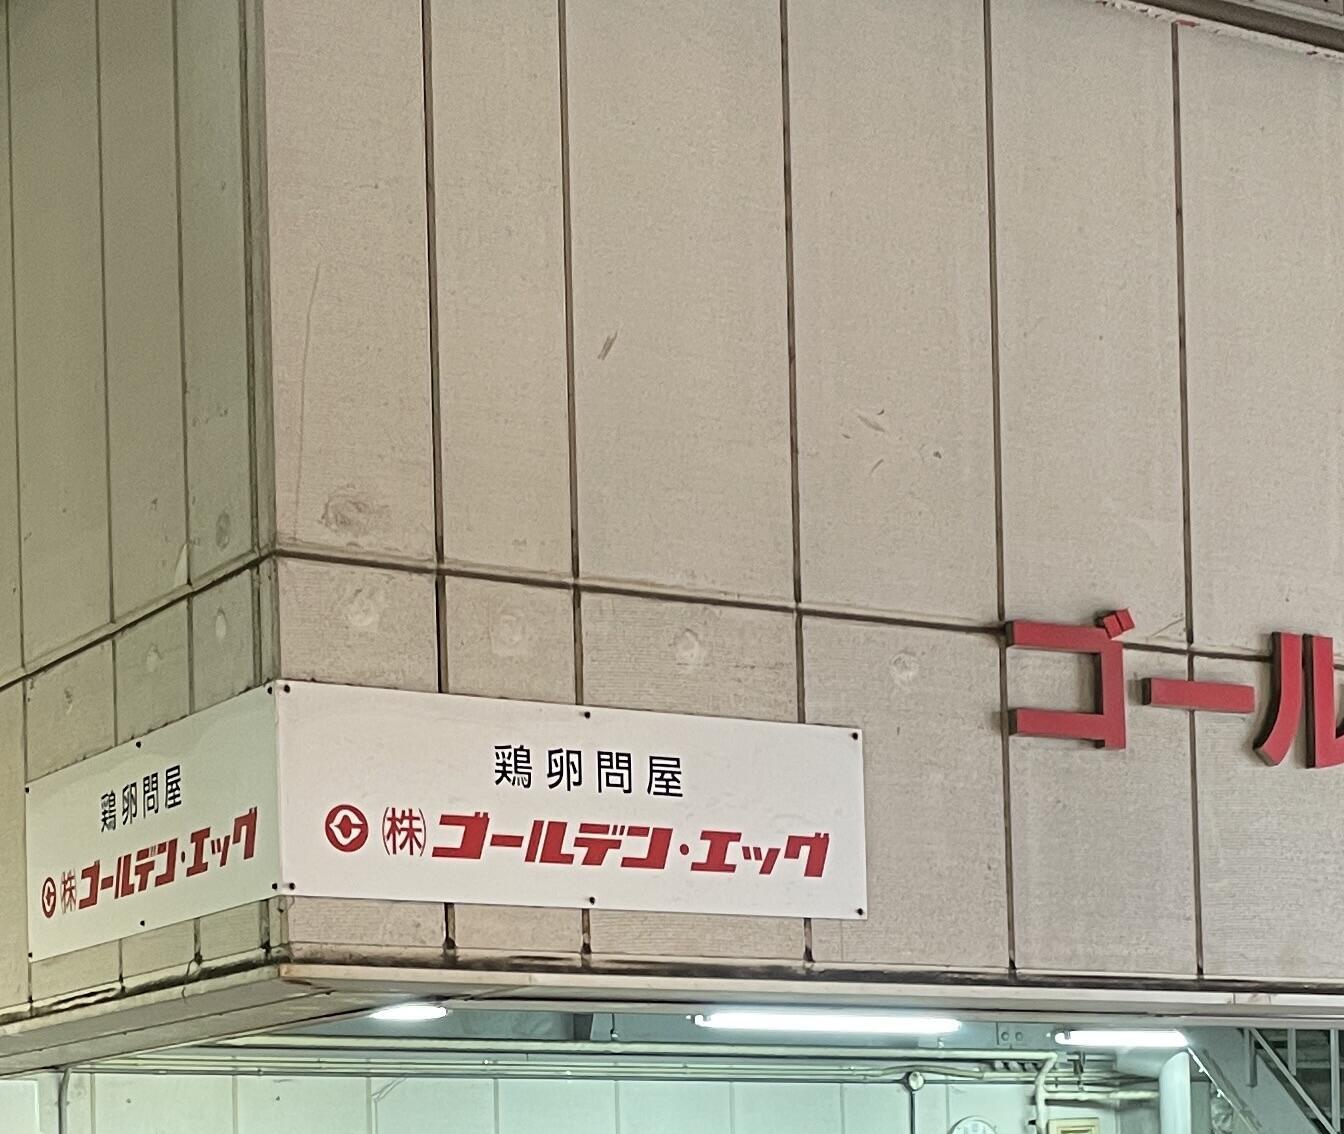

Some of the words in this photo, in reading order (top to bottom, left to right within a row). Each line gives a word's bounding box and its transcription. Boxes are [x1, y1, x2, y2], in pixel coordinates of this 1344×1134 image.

[100, 764, 183, 833] 鶏卵問屋
[493, 743, 684, 798] 鶏卵問屋
